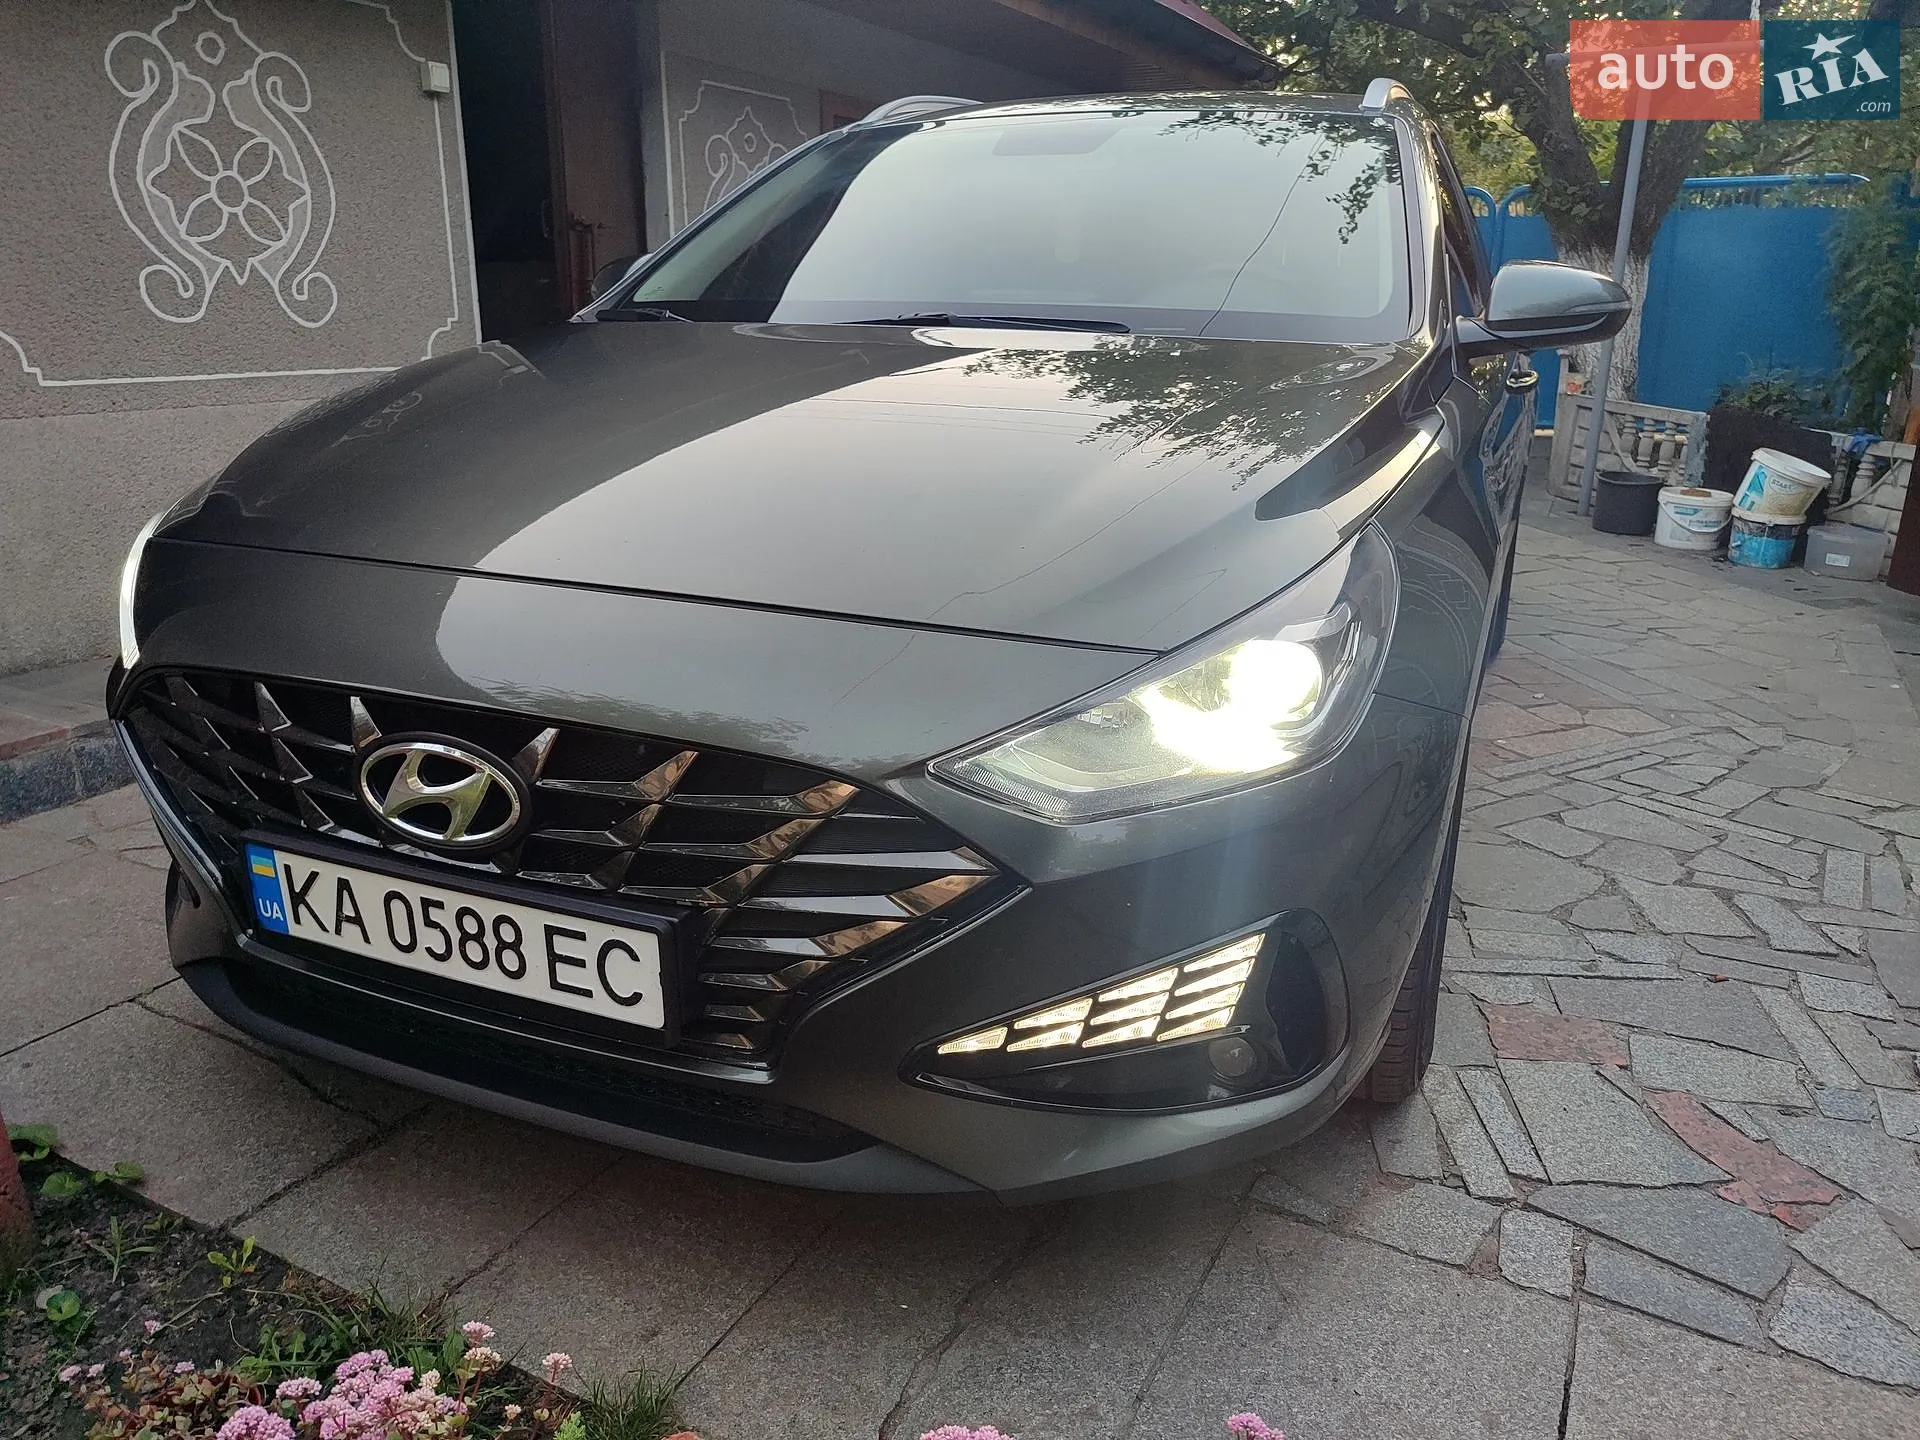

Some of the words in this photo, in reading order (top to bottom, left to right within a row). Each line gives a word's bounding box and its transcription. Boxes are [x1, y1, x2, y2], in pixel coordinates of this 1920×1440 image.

[258, 897, 284, 921] UA
[283, 863, 372, 945] KA
[383, 889, 527, 981] 0588
[543, 923, 644, 1007] EC
